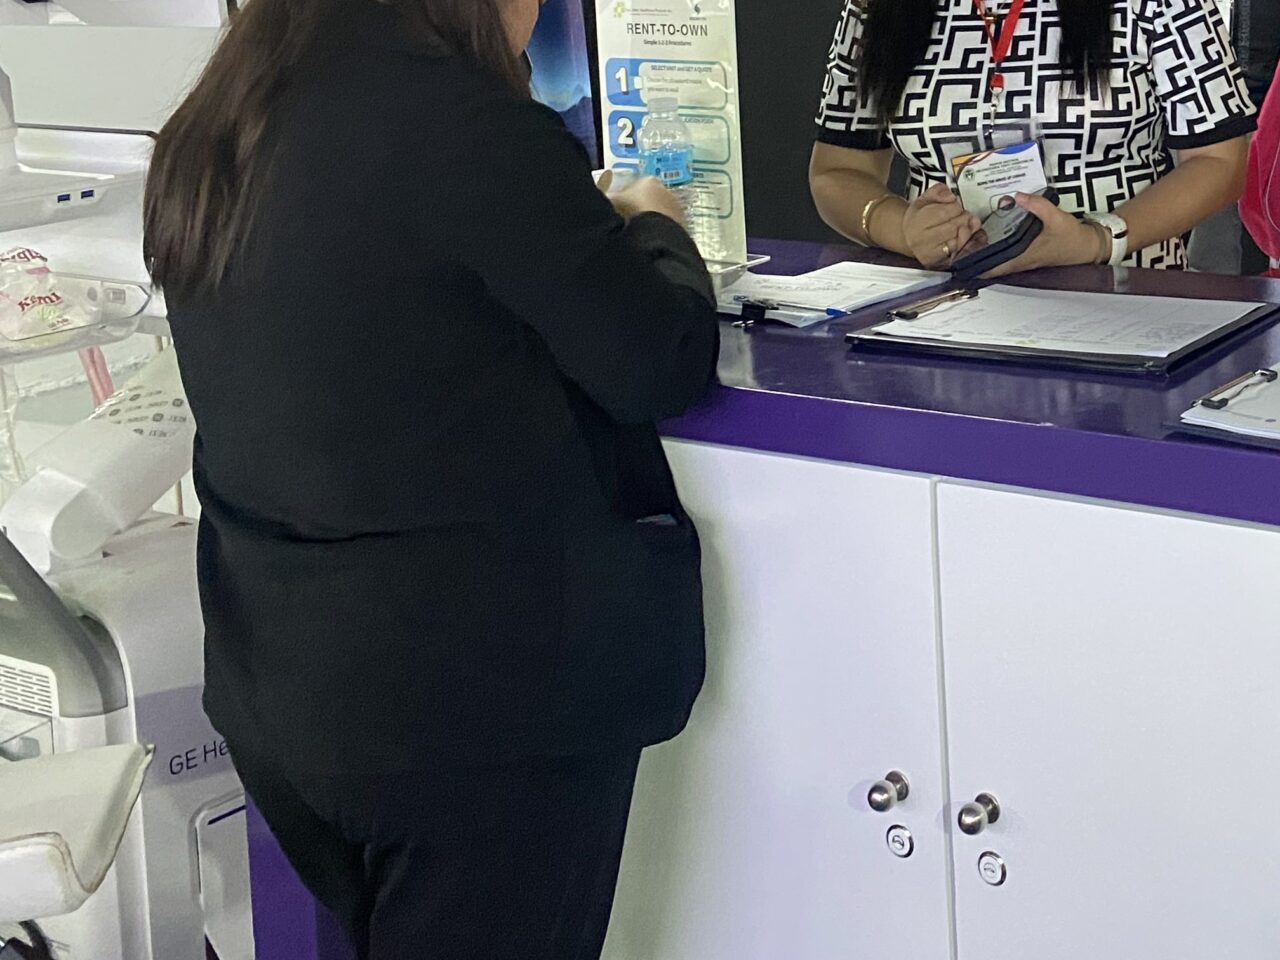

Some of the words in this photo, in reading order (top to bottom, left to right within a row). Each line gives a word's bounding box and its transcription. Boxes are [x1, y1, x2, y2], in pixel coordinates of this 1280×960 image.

[626, 23, 708, 36] RENT-TO-OWN
[615, 67, 628, 93] 1
[617, 118, 634, 145] 2
[169, 748, 198, 775] GE
